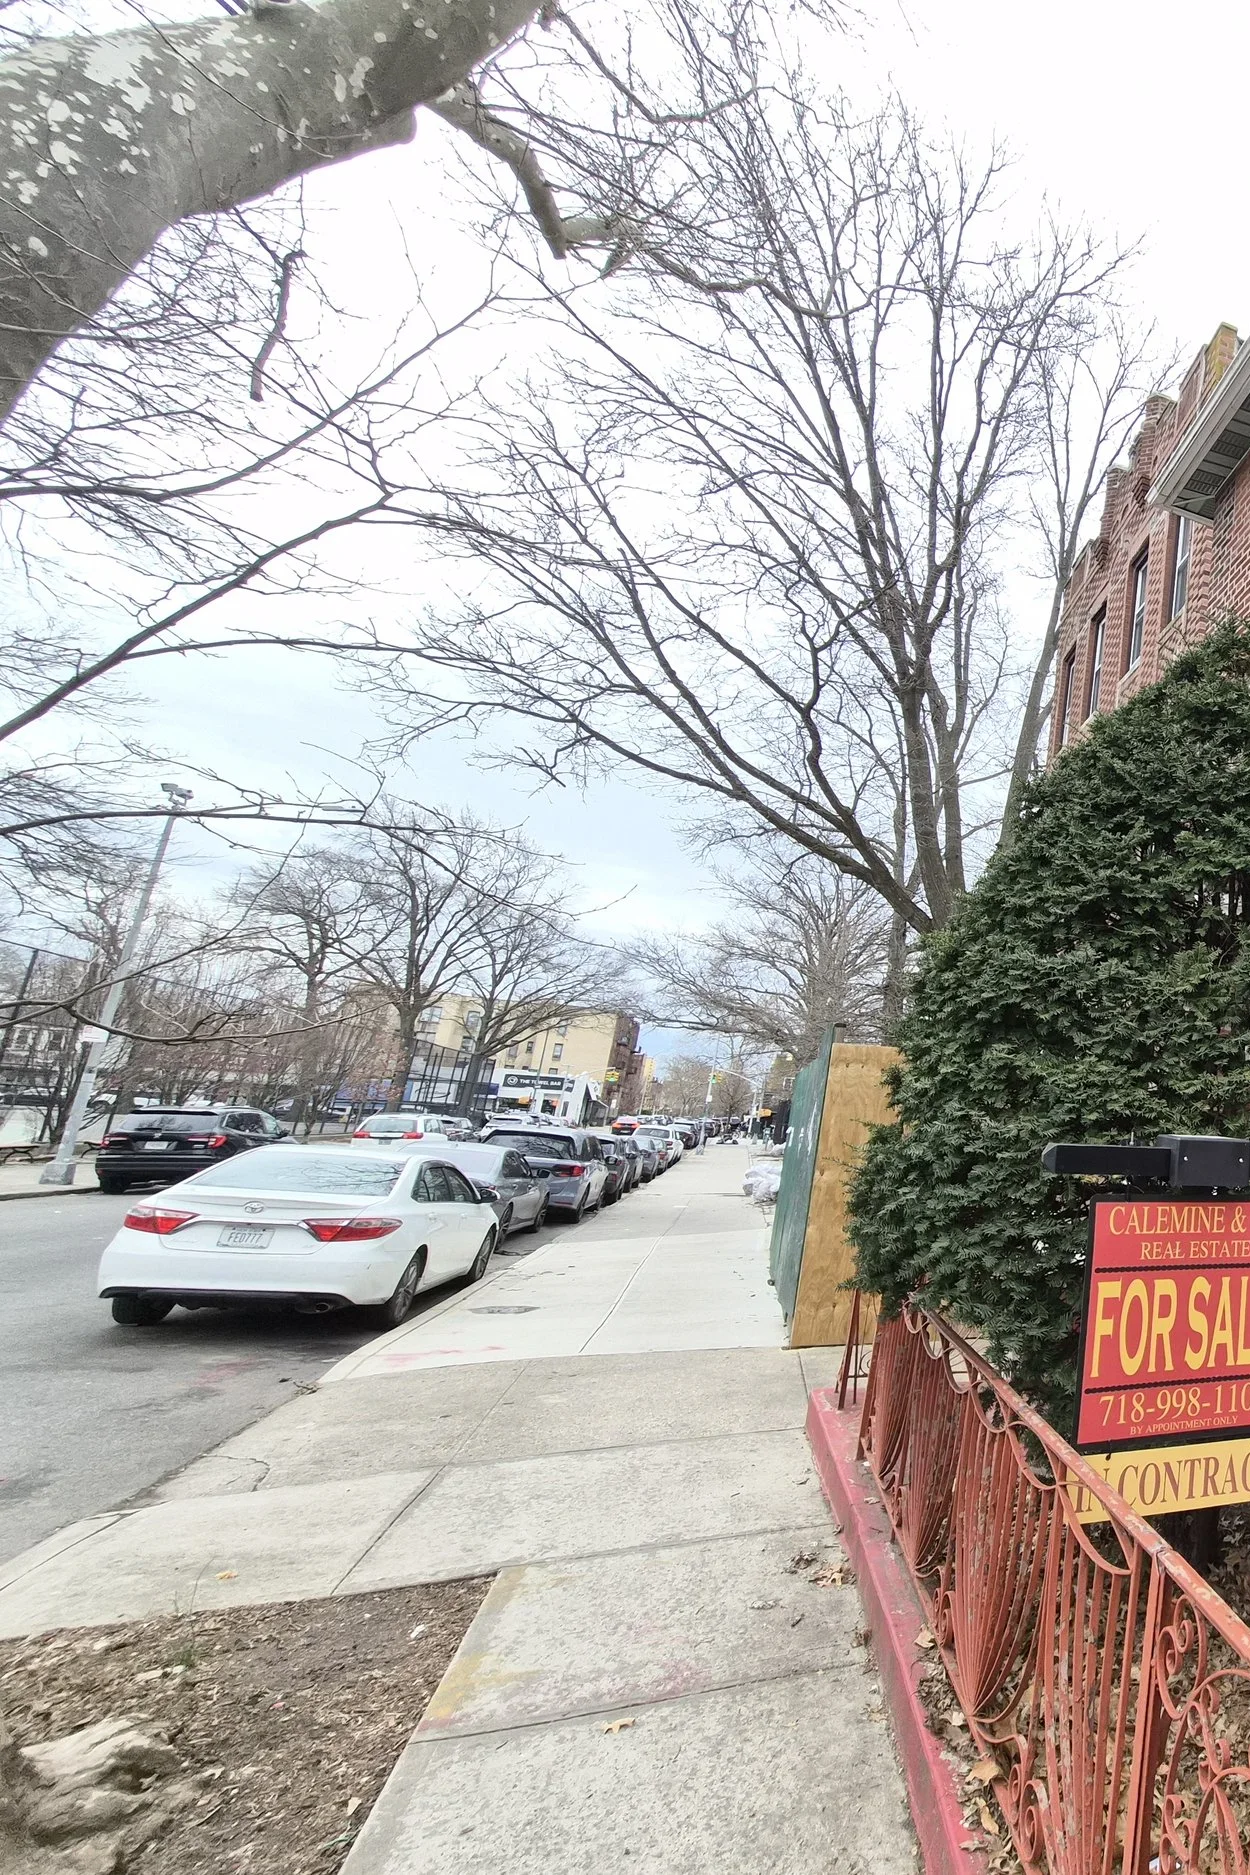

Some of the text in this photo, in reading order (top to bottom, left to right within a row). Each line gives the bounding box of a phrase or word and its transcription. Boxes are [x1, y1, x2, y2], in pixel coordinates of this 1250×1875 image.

[1109, 1206, 1225, 1235] CALEMINE
[1231, 1206, 1247, 1233] &
[1140, 1240, 1250, 1260] REAL ESTATE
[1089, 1276, 1178, 1378] FOR
[1130, 1415, 1238, 1435] BY APPOINTMENT ONLY
